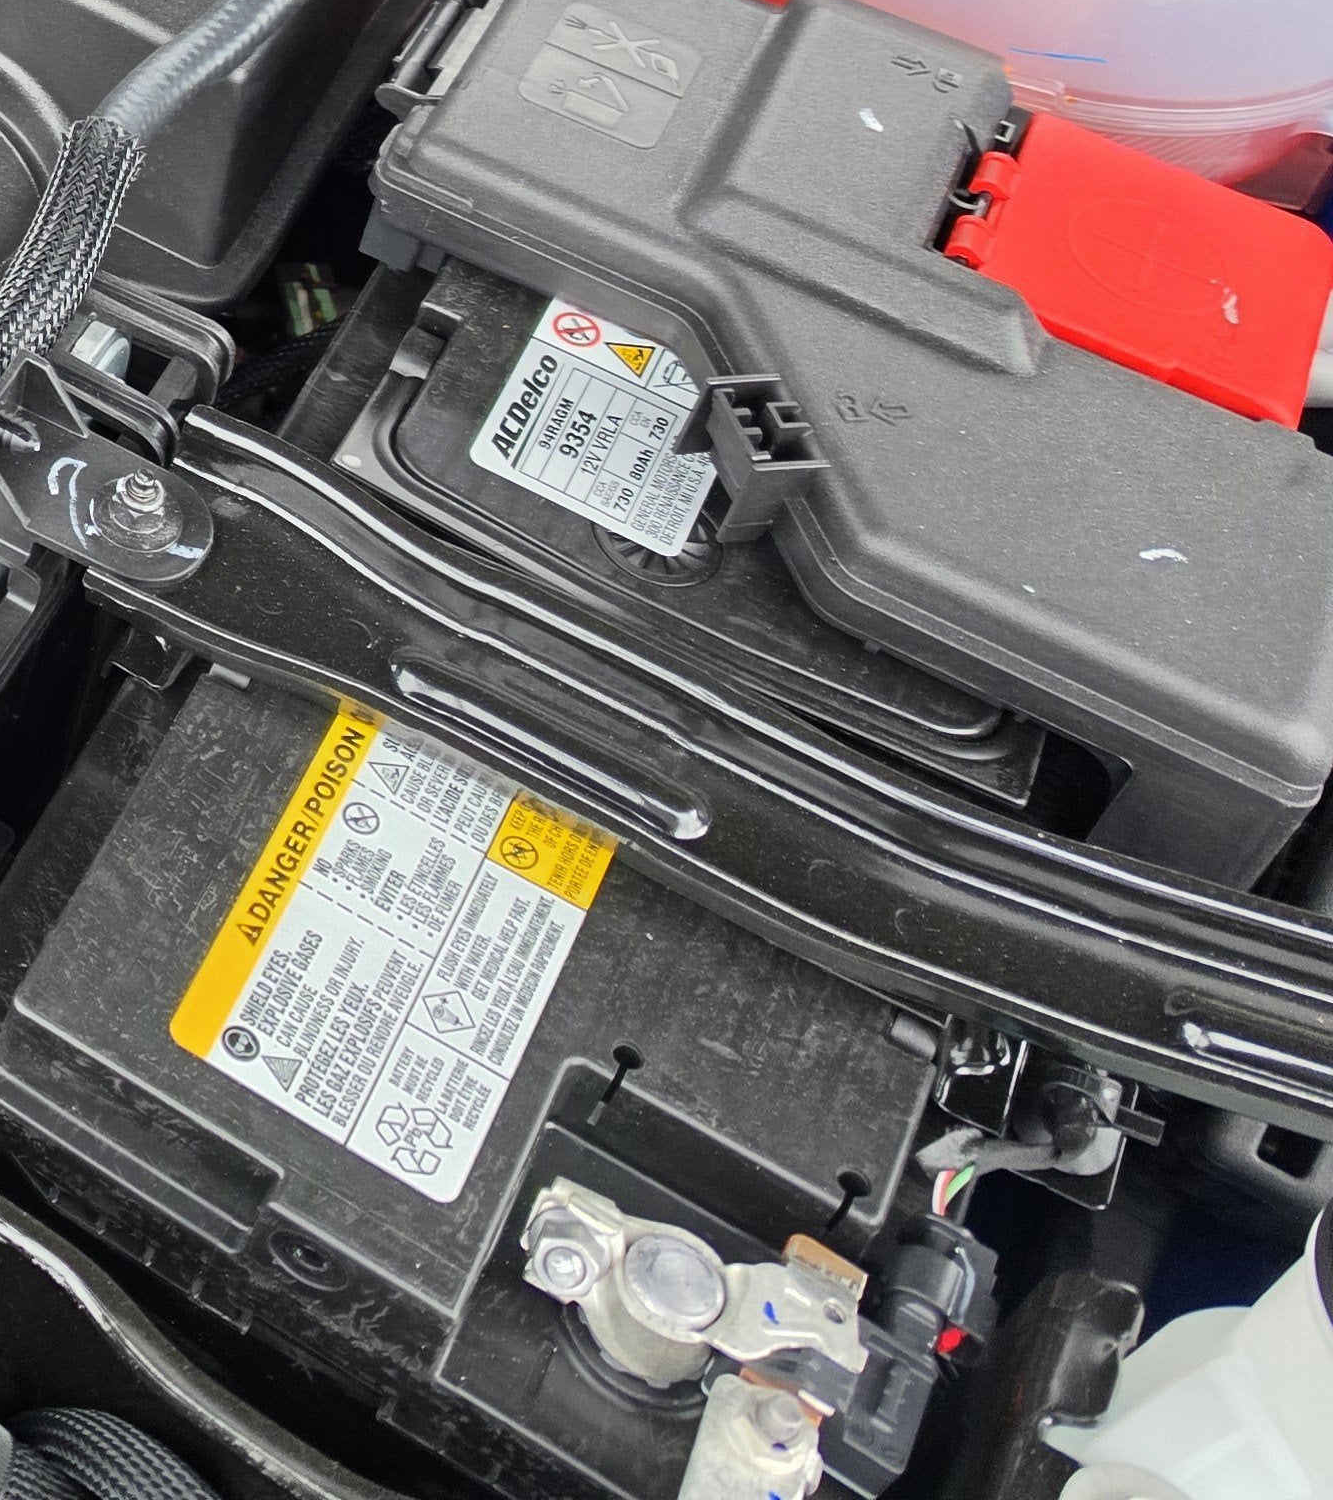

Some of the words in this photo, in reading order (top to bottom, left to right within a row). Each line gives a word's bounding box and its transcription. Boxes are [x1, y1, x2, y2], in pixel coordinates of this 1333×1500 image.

[493, 356, 557, 458] ACDelco
[539, 398, 573, 449] 94RAGM
[629, 411, 643, 426] CCA
[559, 410, 596, 458] 9354
[581, 451, 602, 475] 12V
[593, 416, 623, 449] VRLA
[649, 417, 669, 440] 730
[629, 450, 654, 480] 80Ah
[593, 481, 607, 497] CCA
[613, 488, 634, 512] 730
[631, 492, 659, 531] GENERAL
[651, 453, 677, 491] MOTORS
[645, 520, 663, 538] 300
[654, 461, 691, 521] RENAISSANCE
[678, 492, 694, 505] MI
[401, 770, 427, 804] CAUSE
[417, 796, 435, 813] OR
[434, 783, 464, 824] L'ACIDE
[249, 728, 364, 922] DANGER/POISON
[454, 805, 477, 834] PEUT
[471, 825, 489, 843] OU
[479, 805, 498, 828] DES
[509, 809, 526, 831] KEEP
[525, 822, 543, 839] THE
[332, 839, 361, 878] SPARKS
[543, 835, 557, 848] OF
[579, 854, 594, 868] DE
[313, 858, 332, 877] NO
[346, 847, 375, 886] FLAMES
[360, 849, 392, 894] SMOKING
[405, 837, 445, 896] ÉTINCELLES
[547, 864, 568, 889] TENIR
[561, 841, 579, 866] HORS
[371, 870, 406, 912] ÉVITER
[397, 894, 417, 916] LES
[412, 902, 432, 924] LES
[422, 854, 455, 904] FLAMMES
[435, 880, 462, 917] FUMER
[427, 914, 445, 932] DE
[437, 950, 461, 982] FLUSH
[451, 927, 472, 952] EYES
[462, 872, 498, 930] IMMEDIATELY
[509, 897, 530, 922] FAST.
[498, 919, 518, 945] HELP
[333, 937, 364, 980] INJURY.
[453, 964, 475, 990] WITH
[465, 935, 491, 967] WATER.
[480, 944, 508, 983] MEDICAL
[240, 982, 272, 1026] SHIELD
[262, 950, 292, 983] EYES.
[258, 969, 302, 1036] EXPLOSIVE
[292, 930, 322, 971] GASES
[325, 977, 344, 996] OR
[389, 962, 423, 1014] AVEUGLE.
[471, 980, 490, 1000] GET
[490, 986, 511, 1010] YEUX
[276, 1020, 299, 1047] CAN
[289, 984, 317, 1023] CAUSE
[293, 995, 334, 1058] BLINDNESS
[313, 1090, 337, 1118] LES
[326, 1063, 351, 1092] GAZ
[339, 999, 382, 1066] EXPLOSIFS
[373, 949, 406, 1001] PEUVENT
[366, 1011, 397, 1058] RENDRE
[483, 1008, 501, 1027] LES
[295, 1040, 338, 1106] PROTÉGEZ
[326, 1016, 350, 1043] LES
[338, 982, 369, 1017] YEUX.
[470, 1024, 494, 1056] RINCEZ
[488, 1018, 519, 1066] CONSULTEZ
[508, 1006, 525, 1021] UN
[357, 1056, 376, 1075] OU
[389, 1046, 414, 1086] BATTERY
[402, 1068, 421, 1095] MUST
[414, 1055, 428, 1069] BE
[416, 1057, 444, 1103] RECYCLED
[441, 1058, 468, 1101] BATTERIE
[332, 1074, 367, 1127] BLESSER
[434, 1100, 449, 1115] LA
[449, 1099, 466, 1122] DOIT
[404, 1127, 424, 1147] Pb
